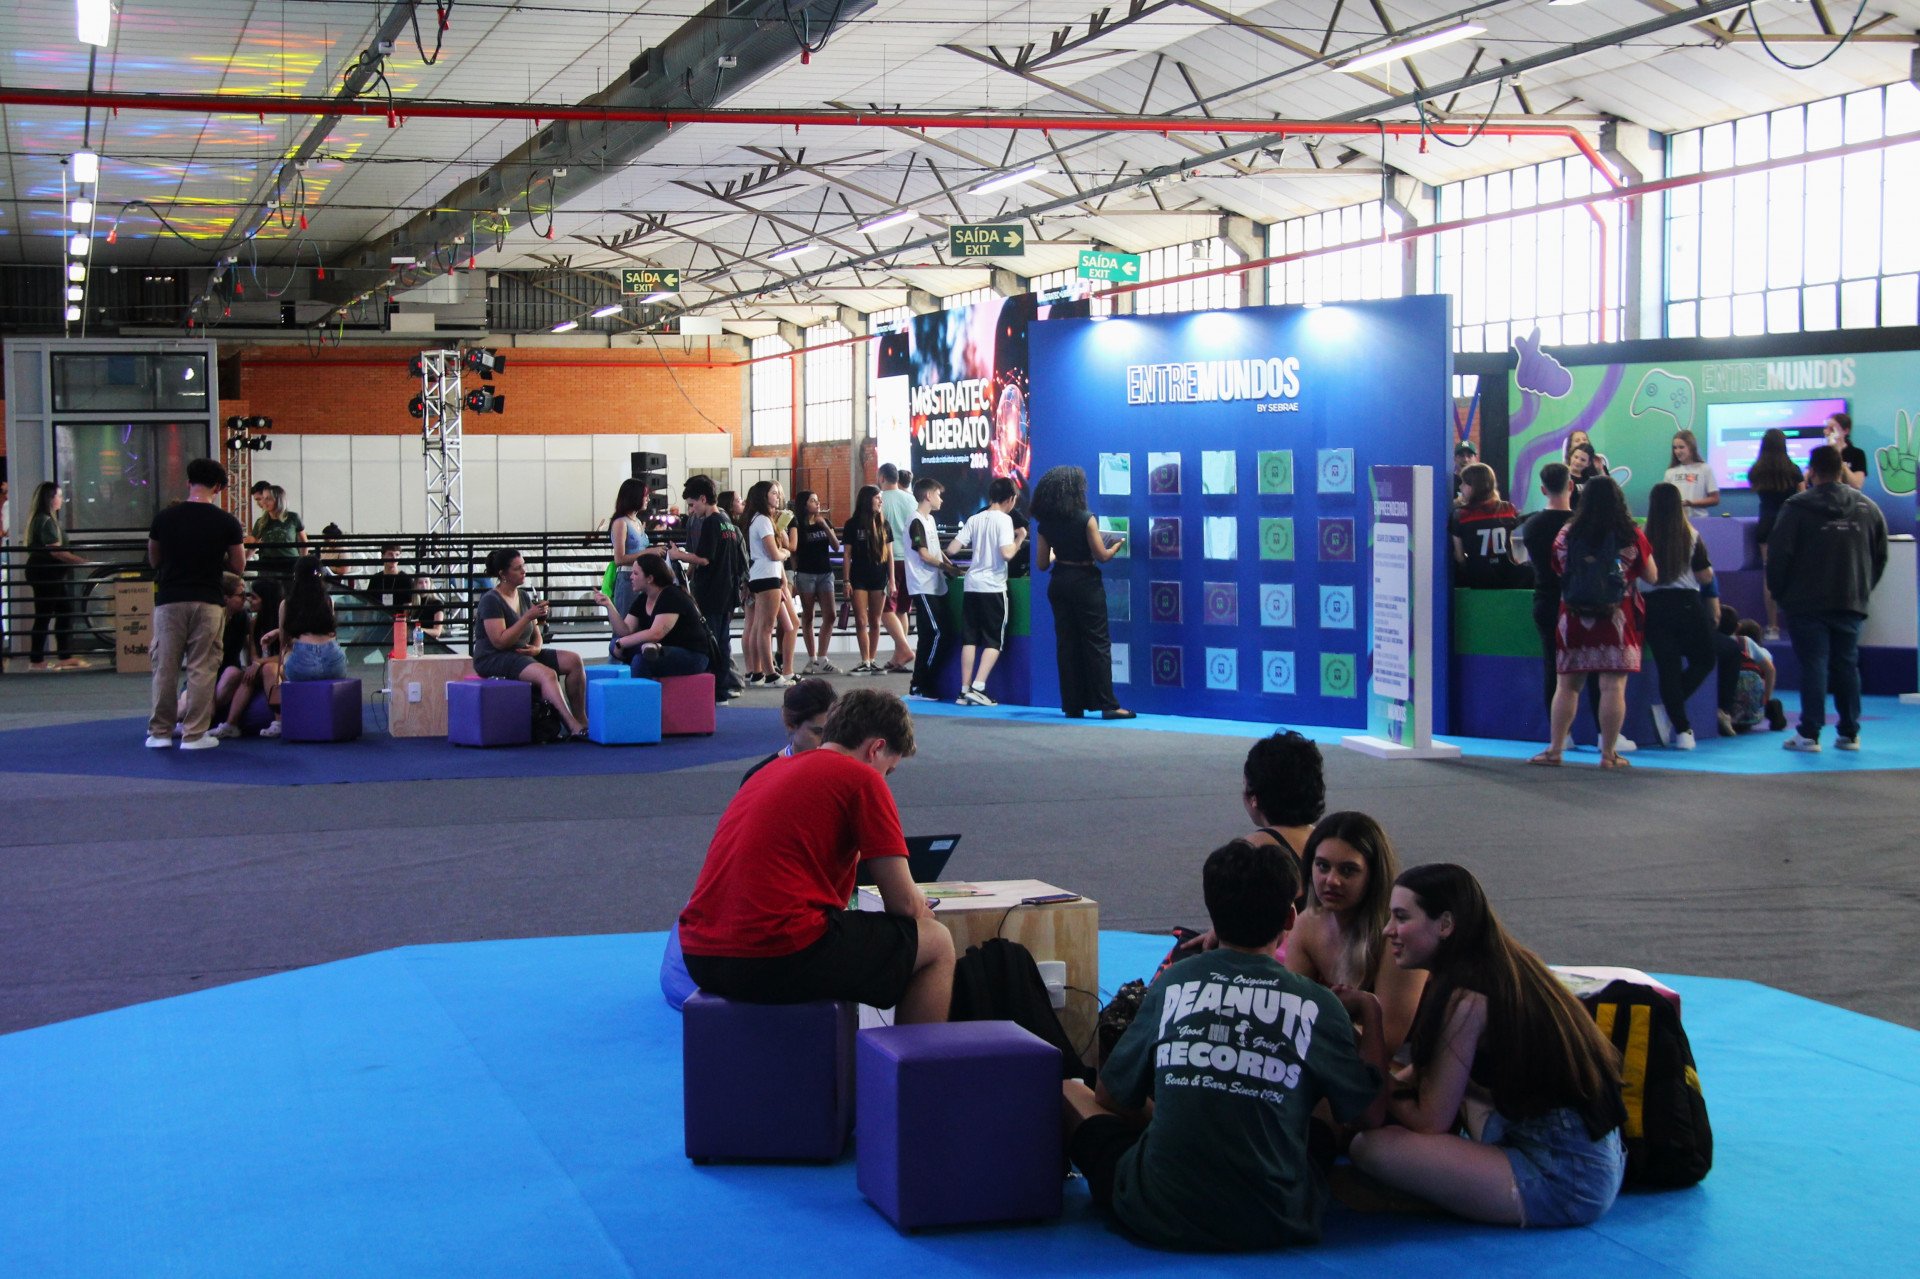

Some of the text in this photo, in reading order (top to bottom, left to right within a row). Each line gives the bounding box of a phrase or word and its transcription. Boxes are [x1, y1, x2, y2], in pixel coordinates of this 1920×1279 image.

[956, 227, 999, 243] SAÍDA
[965, 244, 990, 256] EXIT
[1082, 255, 1118, 270] SAÍDA
[626, 271, 660, 283] SAÍDA
[1089, 268, 1110, 279] EXIT
[634, 284, 653, 292] EXIT
[1127, 356, 1300, 405] ENTREMUNDOS
[1702, 357, 1856, 393] ENTREMUNDOS
[911, 378, 990, 416] MOSTRATEC
[1257, 402, 1298, 412] BY SEBRAE
[925, 415, 990, 451] LIBERATO
[970, 453, 988, 468] 2024
[1476, 527, 1507, 556] 70
[1210, 972, 1279, 986] The Original
[1158, 980, 1319, 1061] PEANUTS
[1156, 1041, 1302, 1090] RECORDS
[1164, 1073, 1283, 1103] Beats & Bars Since 1950
